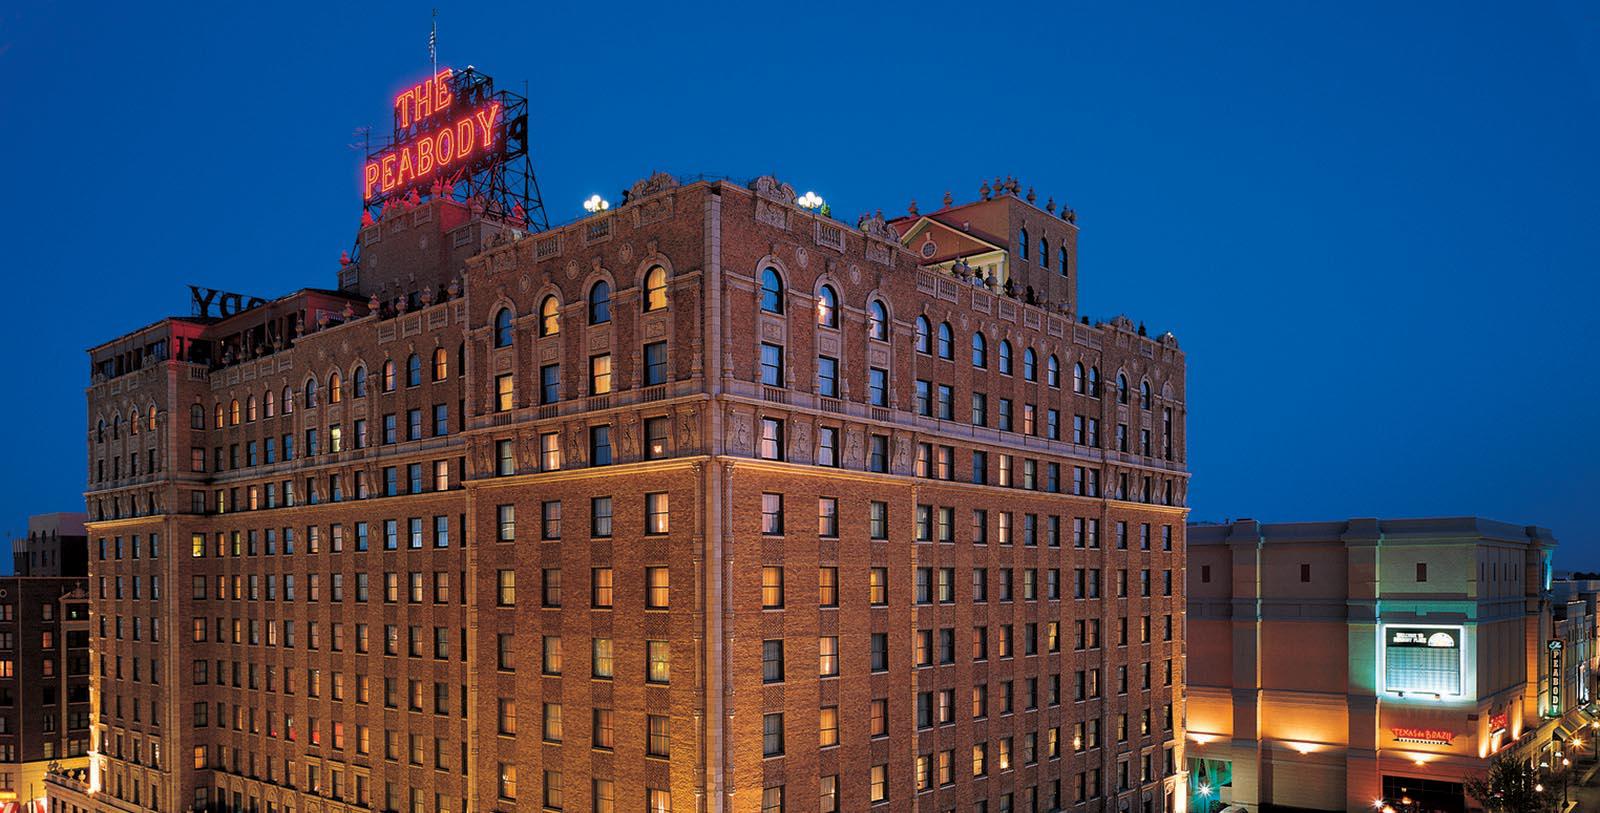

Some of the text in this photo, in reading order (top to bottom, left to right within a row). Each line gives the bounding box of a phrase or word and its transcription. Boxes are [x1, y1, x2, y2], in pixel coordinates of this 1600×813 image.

[395, 69, 453, 128] THE
[364, 100, 500, 200] PEABODY
[1392, 728, 1418, 738] TEXAS
[1425, 730, 1453, 742] BRAZIL
